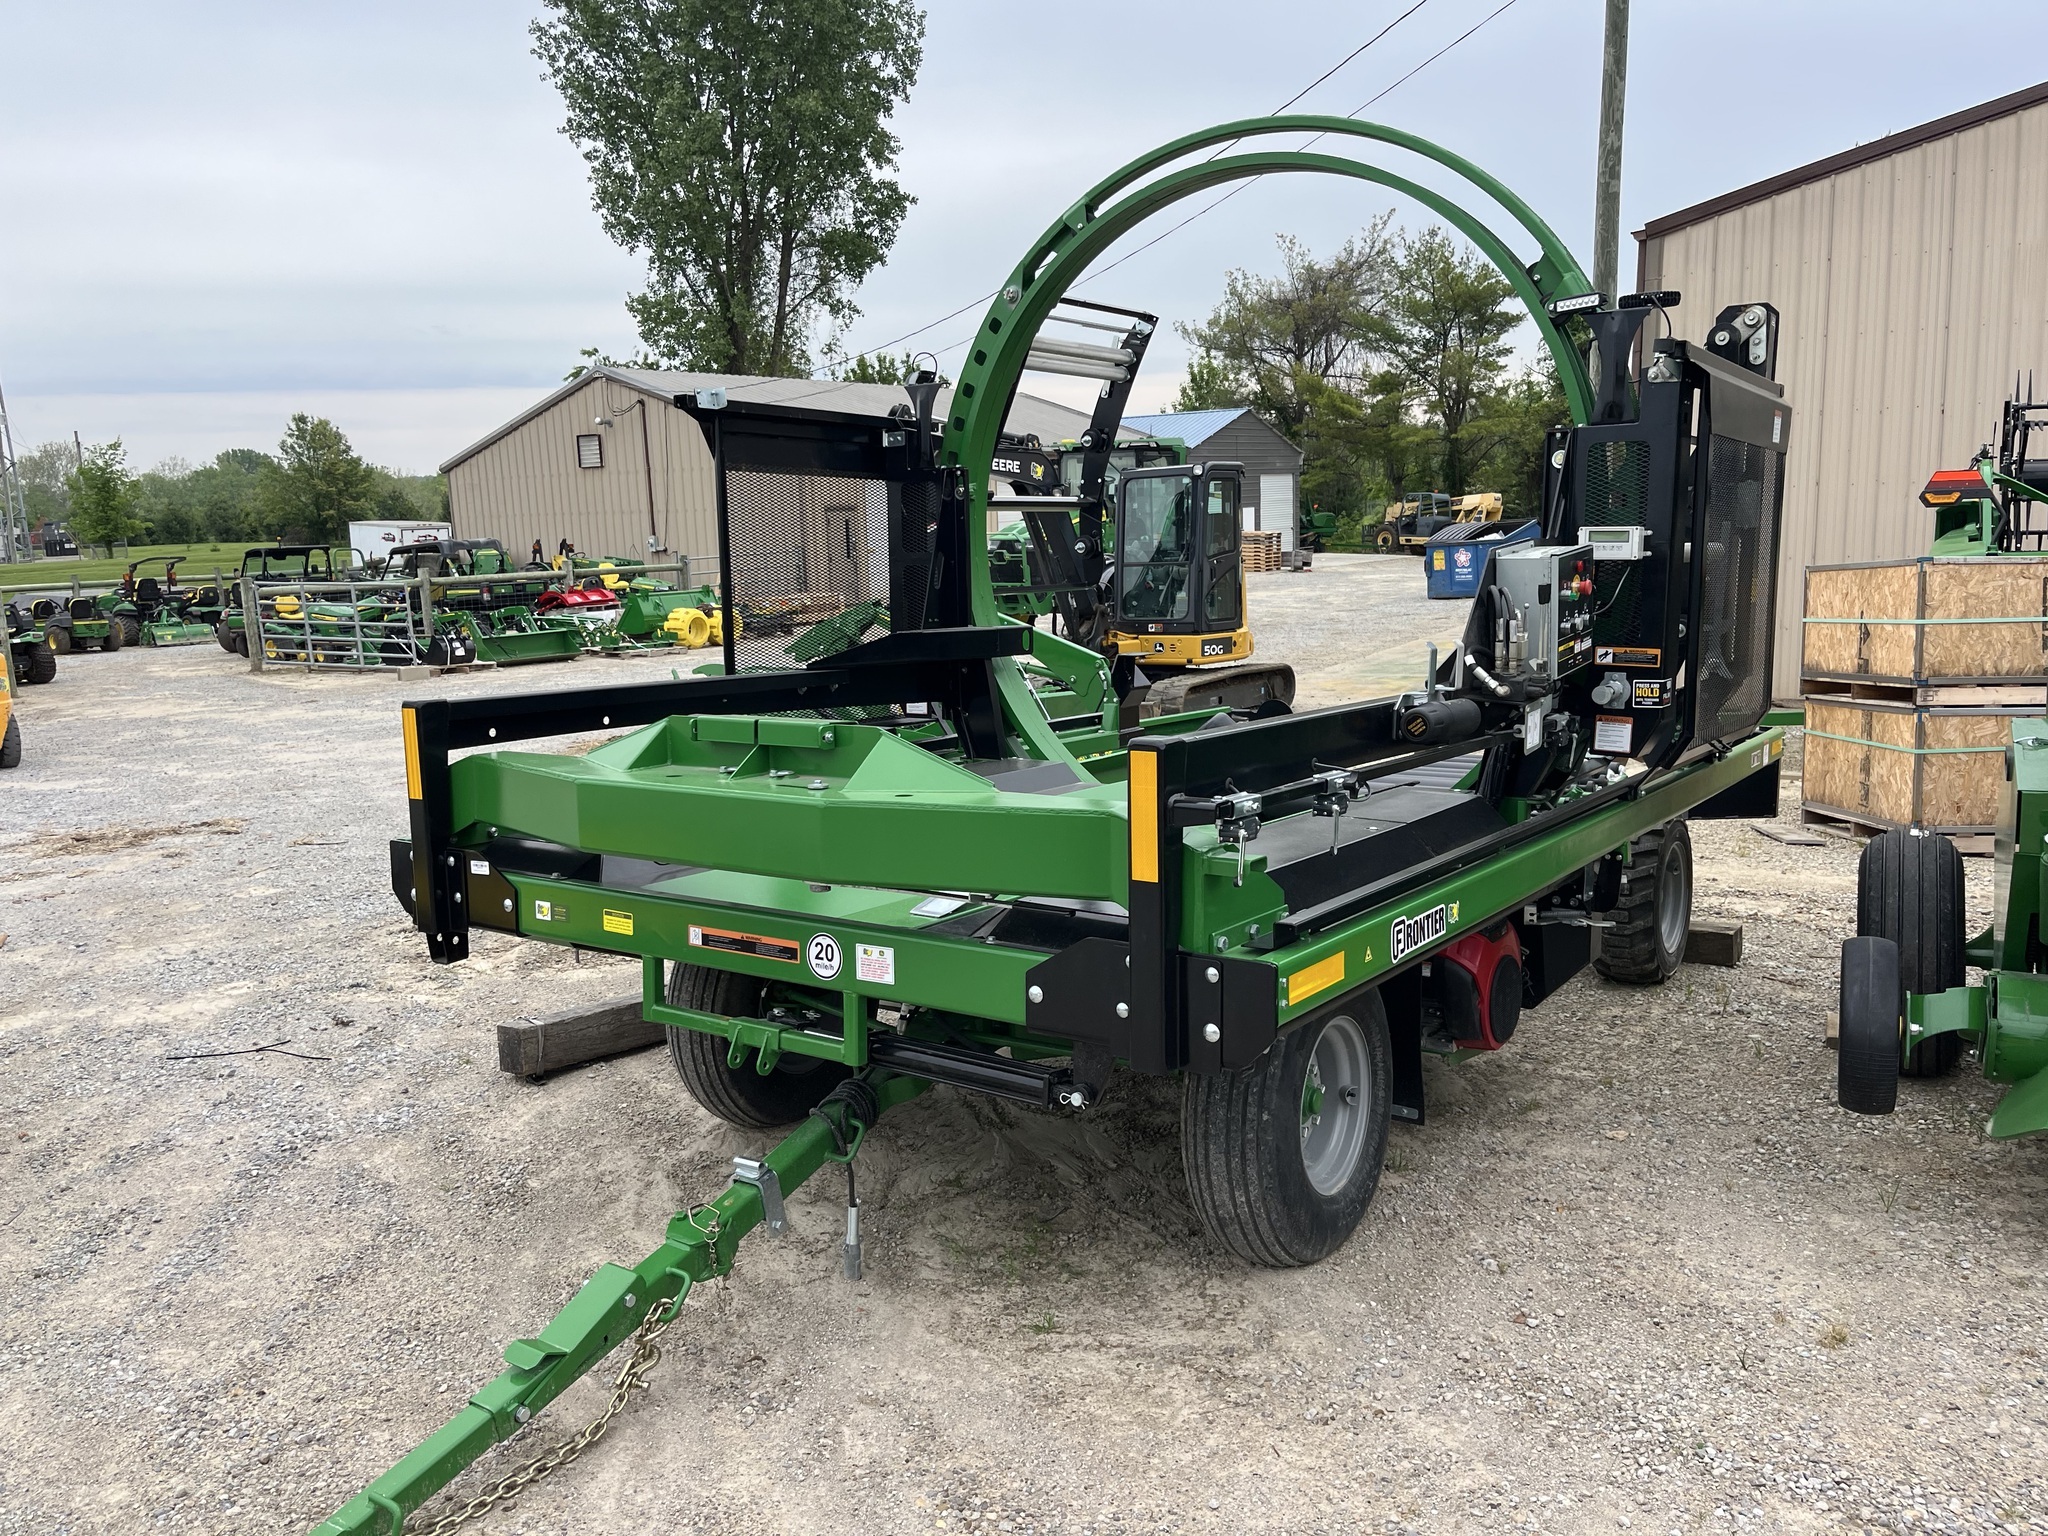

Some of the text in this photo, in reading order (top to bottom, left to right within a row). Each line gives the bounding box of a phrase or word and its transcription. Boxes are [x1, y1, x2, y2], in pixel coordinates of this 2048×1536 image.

[992, 458, 1020, 473] EERE
[1204, 644, 1224, 656] 50G
[1636, 688, 1660, 697] HOLD
[1392, 907, 1445, 961] FRONTIER
[814, 942, 835, 963] 20
[815, 962, 835, 971] mile/h
